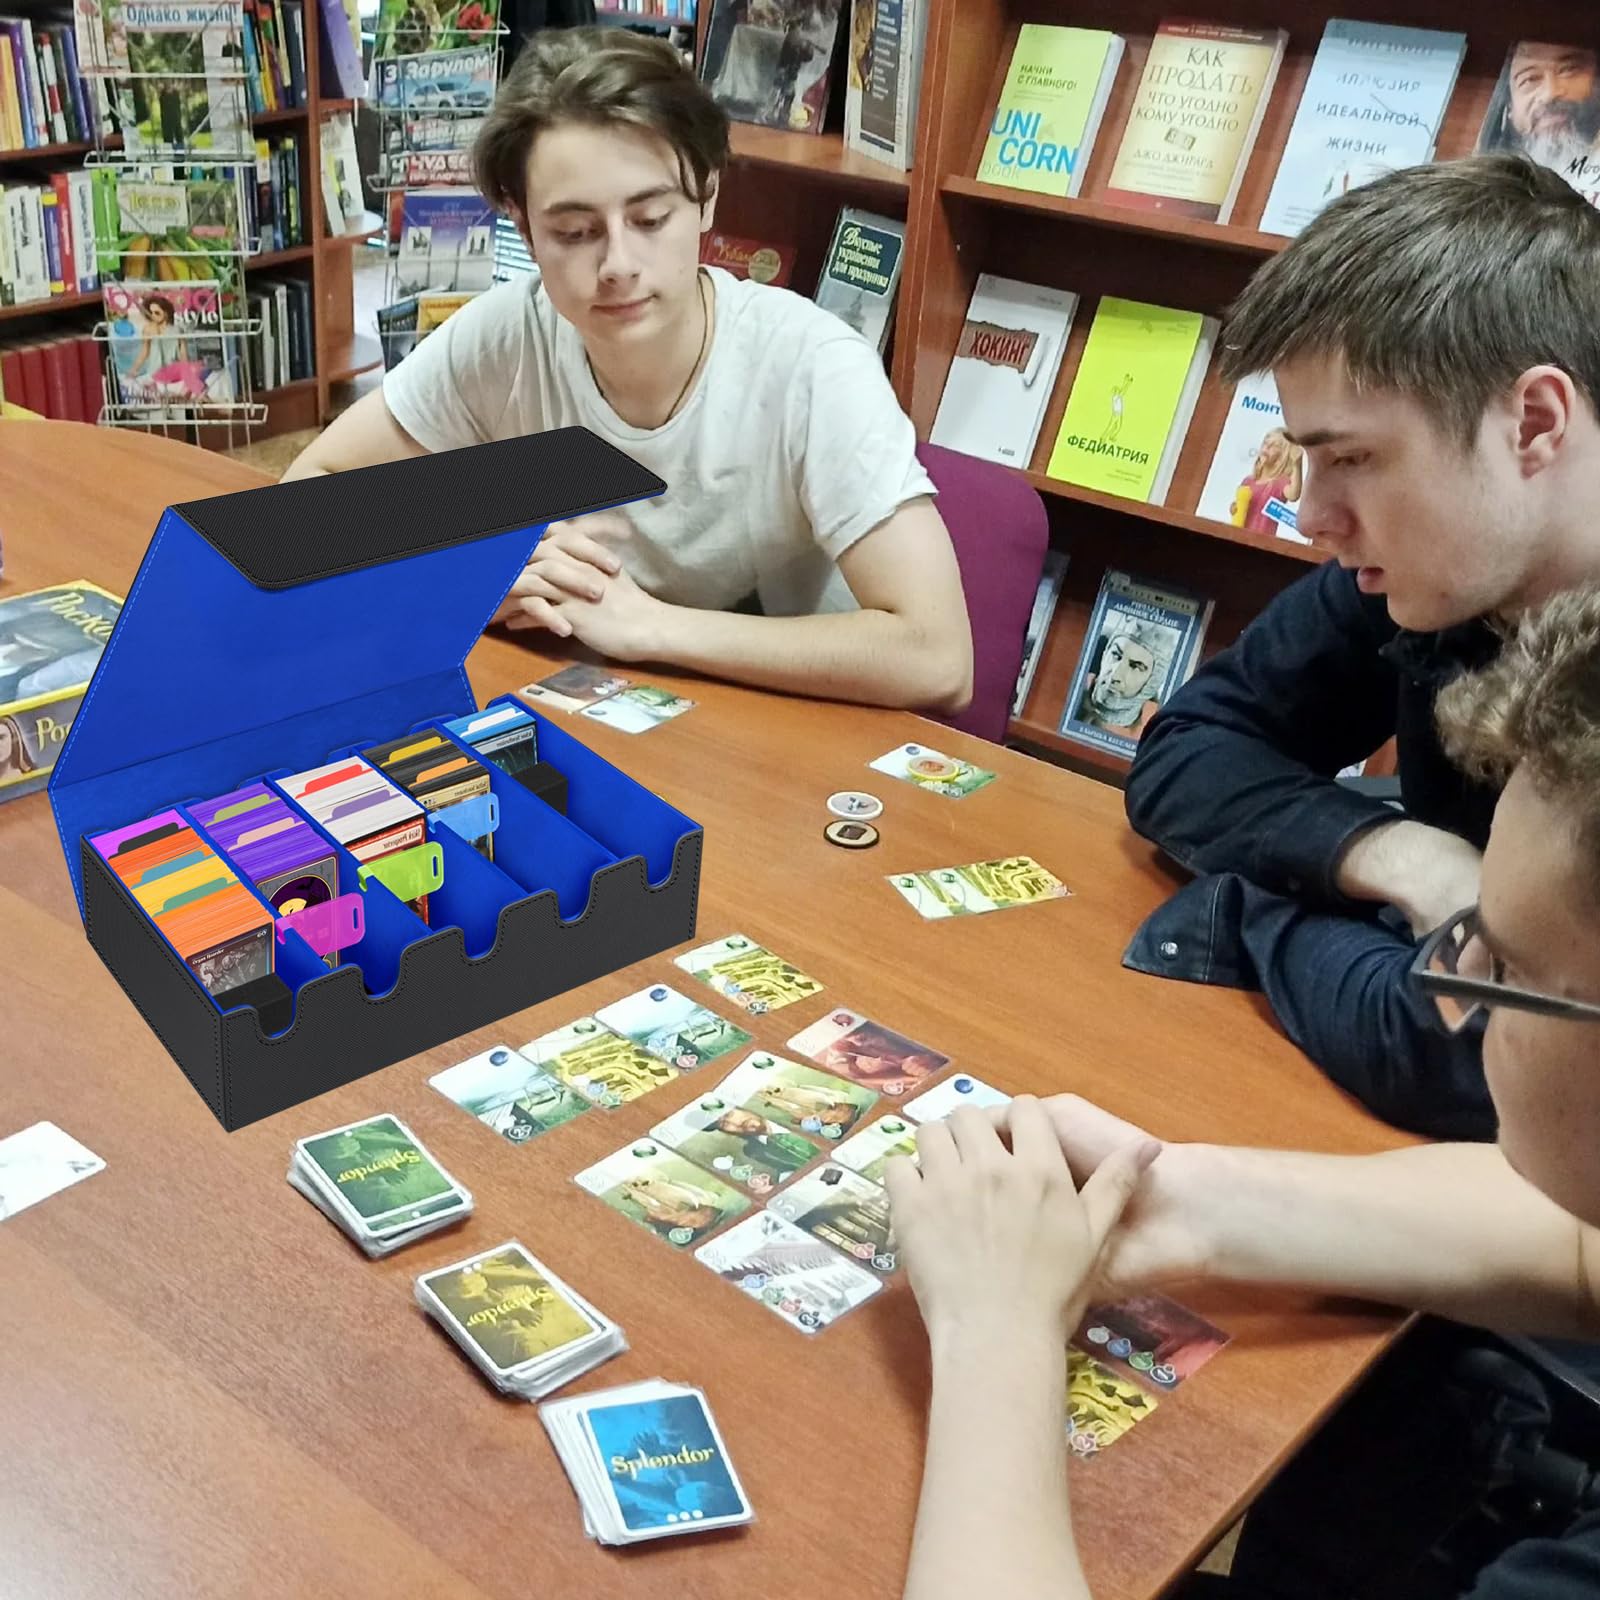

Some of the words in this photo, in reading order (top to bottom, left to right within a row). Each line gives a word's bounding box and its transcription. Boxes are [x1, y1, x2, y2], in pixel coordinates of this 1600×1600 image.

[126, 5, 181, 25] Однако
[1020, 64, 1053, 76] НАЧНИ
[1187, 47, 1227, 68] КАК
[1147, 64, 1253, 95] ПРОДАТЬ
[1148, 91, 1176, 106] ЧТО
[1178, 94, 1239, 114] УГОДНО
[1316, 102, 1420, 127] ИДЕАЛЬНОЙ
[991, 109, 1042, 139] UNI
[1135, 107, 1177, 125] КОМУ
[1180, 113, 1239, 132] УГОДНО
[998, 138, 1080, 175] CORN
[1325, 135, 1388, 156] ЖИЗНИ
[174, 308, 218, 326] style
[970, 330, 1030, 366] ХОКИНГ
[1067, 434, 1149, 465] ФЕДИАТРИЯ
[336, 1147, 421, 1185] Splendor
[465, 1285, 553, 1328] Splendor
[611, 1444, 715, 1481] Splendor
